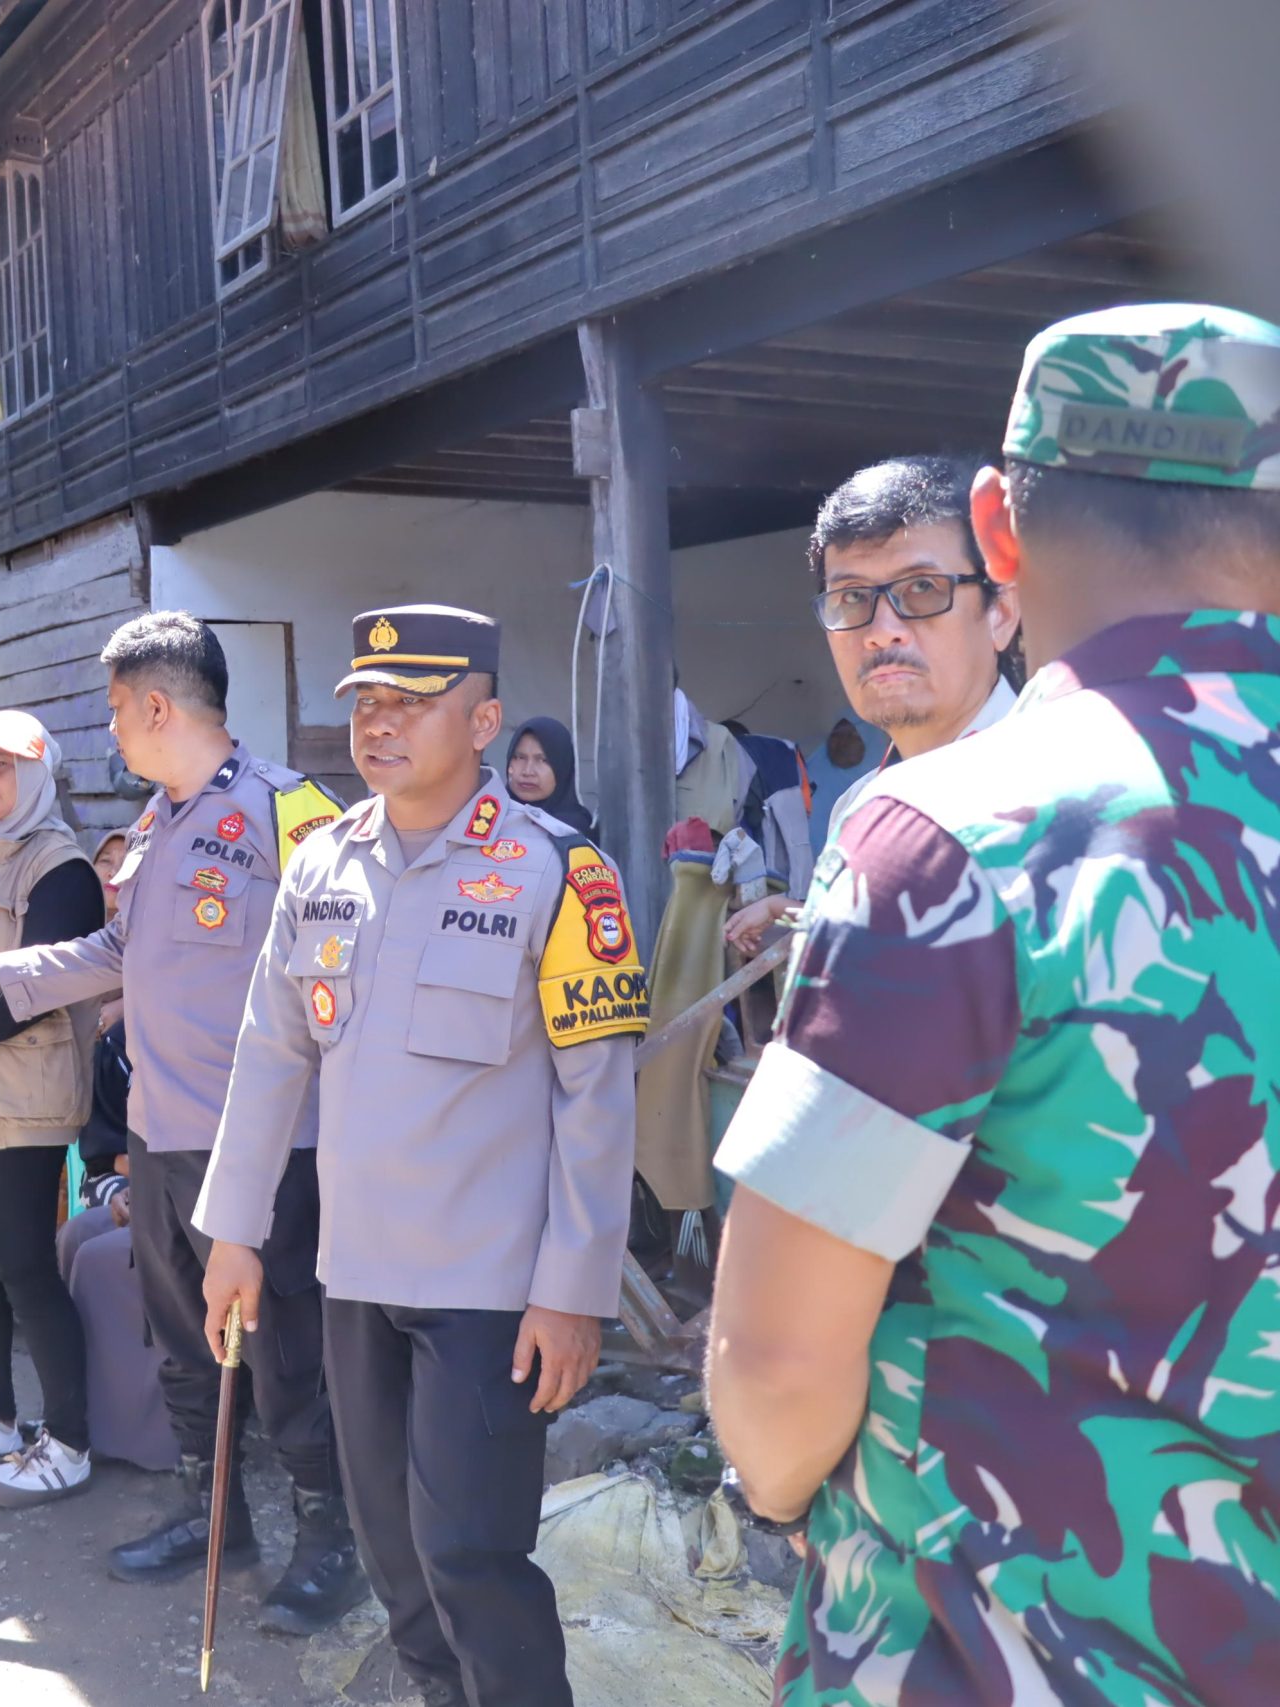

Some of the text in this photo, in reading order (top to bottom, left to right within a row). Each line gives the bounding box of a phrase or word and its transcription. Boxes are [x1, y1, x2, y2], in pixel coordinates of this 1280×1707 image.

[1065, 415, 1226, 456] DANDIM
[191, 837, 255, 869] POLRI
[302, 901, 355, 921] ANDIKO
[441, 909, 517, 938] POLRI
[552, 1015, 578, 1031] OMP
[581, 1002, 635, 1024] PALLAWA
